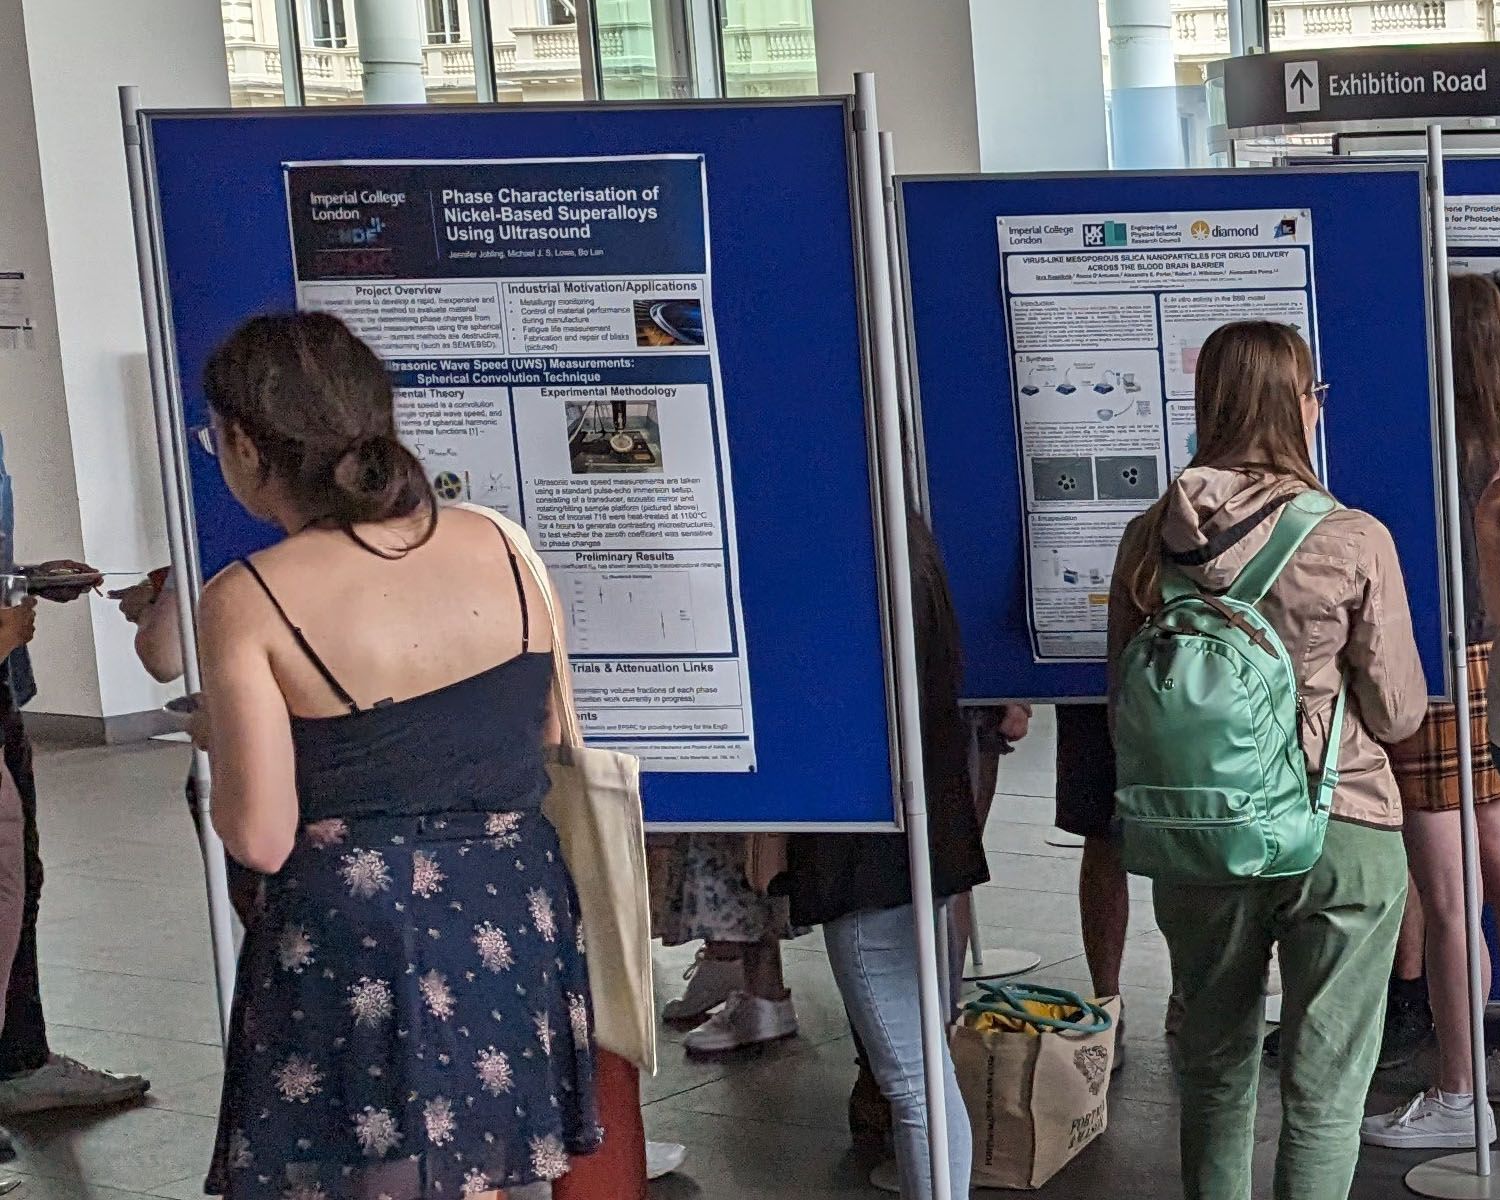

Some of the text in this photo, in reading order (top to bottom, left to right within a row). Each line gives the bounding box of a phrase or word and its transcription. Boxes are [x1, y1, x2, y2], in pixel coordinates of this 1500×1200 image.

[1329, 69, 1486, 97] Exhibition Road
[310, 190, 406, 207] Imperial College
[442, 186, 659, 204] Phase Characterisation of
[312, 207, 359, 221] London
[444, 205, 658, 223] Nickel-Based Superalloys
[446, 224, 591, 244] Using Ultrasound
[1008, 225, 1074, 236] Imperial College
[1130, 224, 1165, 232] Engineering
[1211, 224, 1259, 238] diamond
[1009, 236, 1042, 245] London
[1066, 255, 1119, 263] MESOPOROUS
[356, 286, 442, 298] Project Overview
[508, 281, 697, 295] Industrial Motivation/Applications
[521, 307, 547, 315] Control
[586, 306, 631, 314] performance
[522, 317, 544, 325] during
[523, 326, 550, 334] Fatigue
[439, 360, 470, 371] Wave
[473, 359, 508, 372] Speed
[511, 359, 547, 371] (UWS)
[550, 358, 635, 369] Measurements:
[417, 372, 601, 385] Spherical Convolution Technique
[431, 389, 465, 400] Theory
[541, 386, 677, 398] Experimental Methodology
[575, 551, 675, 563] Preliminary Results
[604, 663, 613, 673] &
[616, 663, 680, 673] Attenuation
[683, 662, 713, 673] Links
